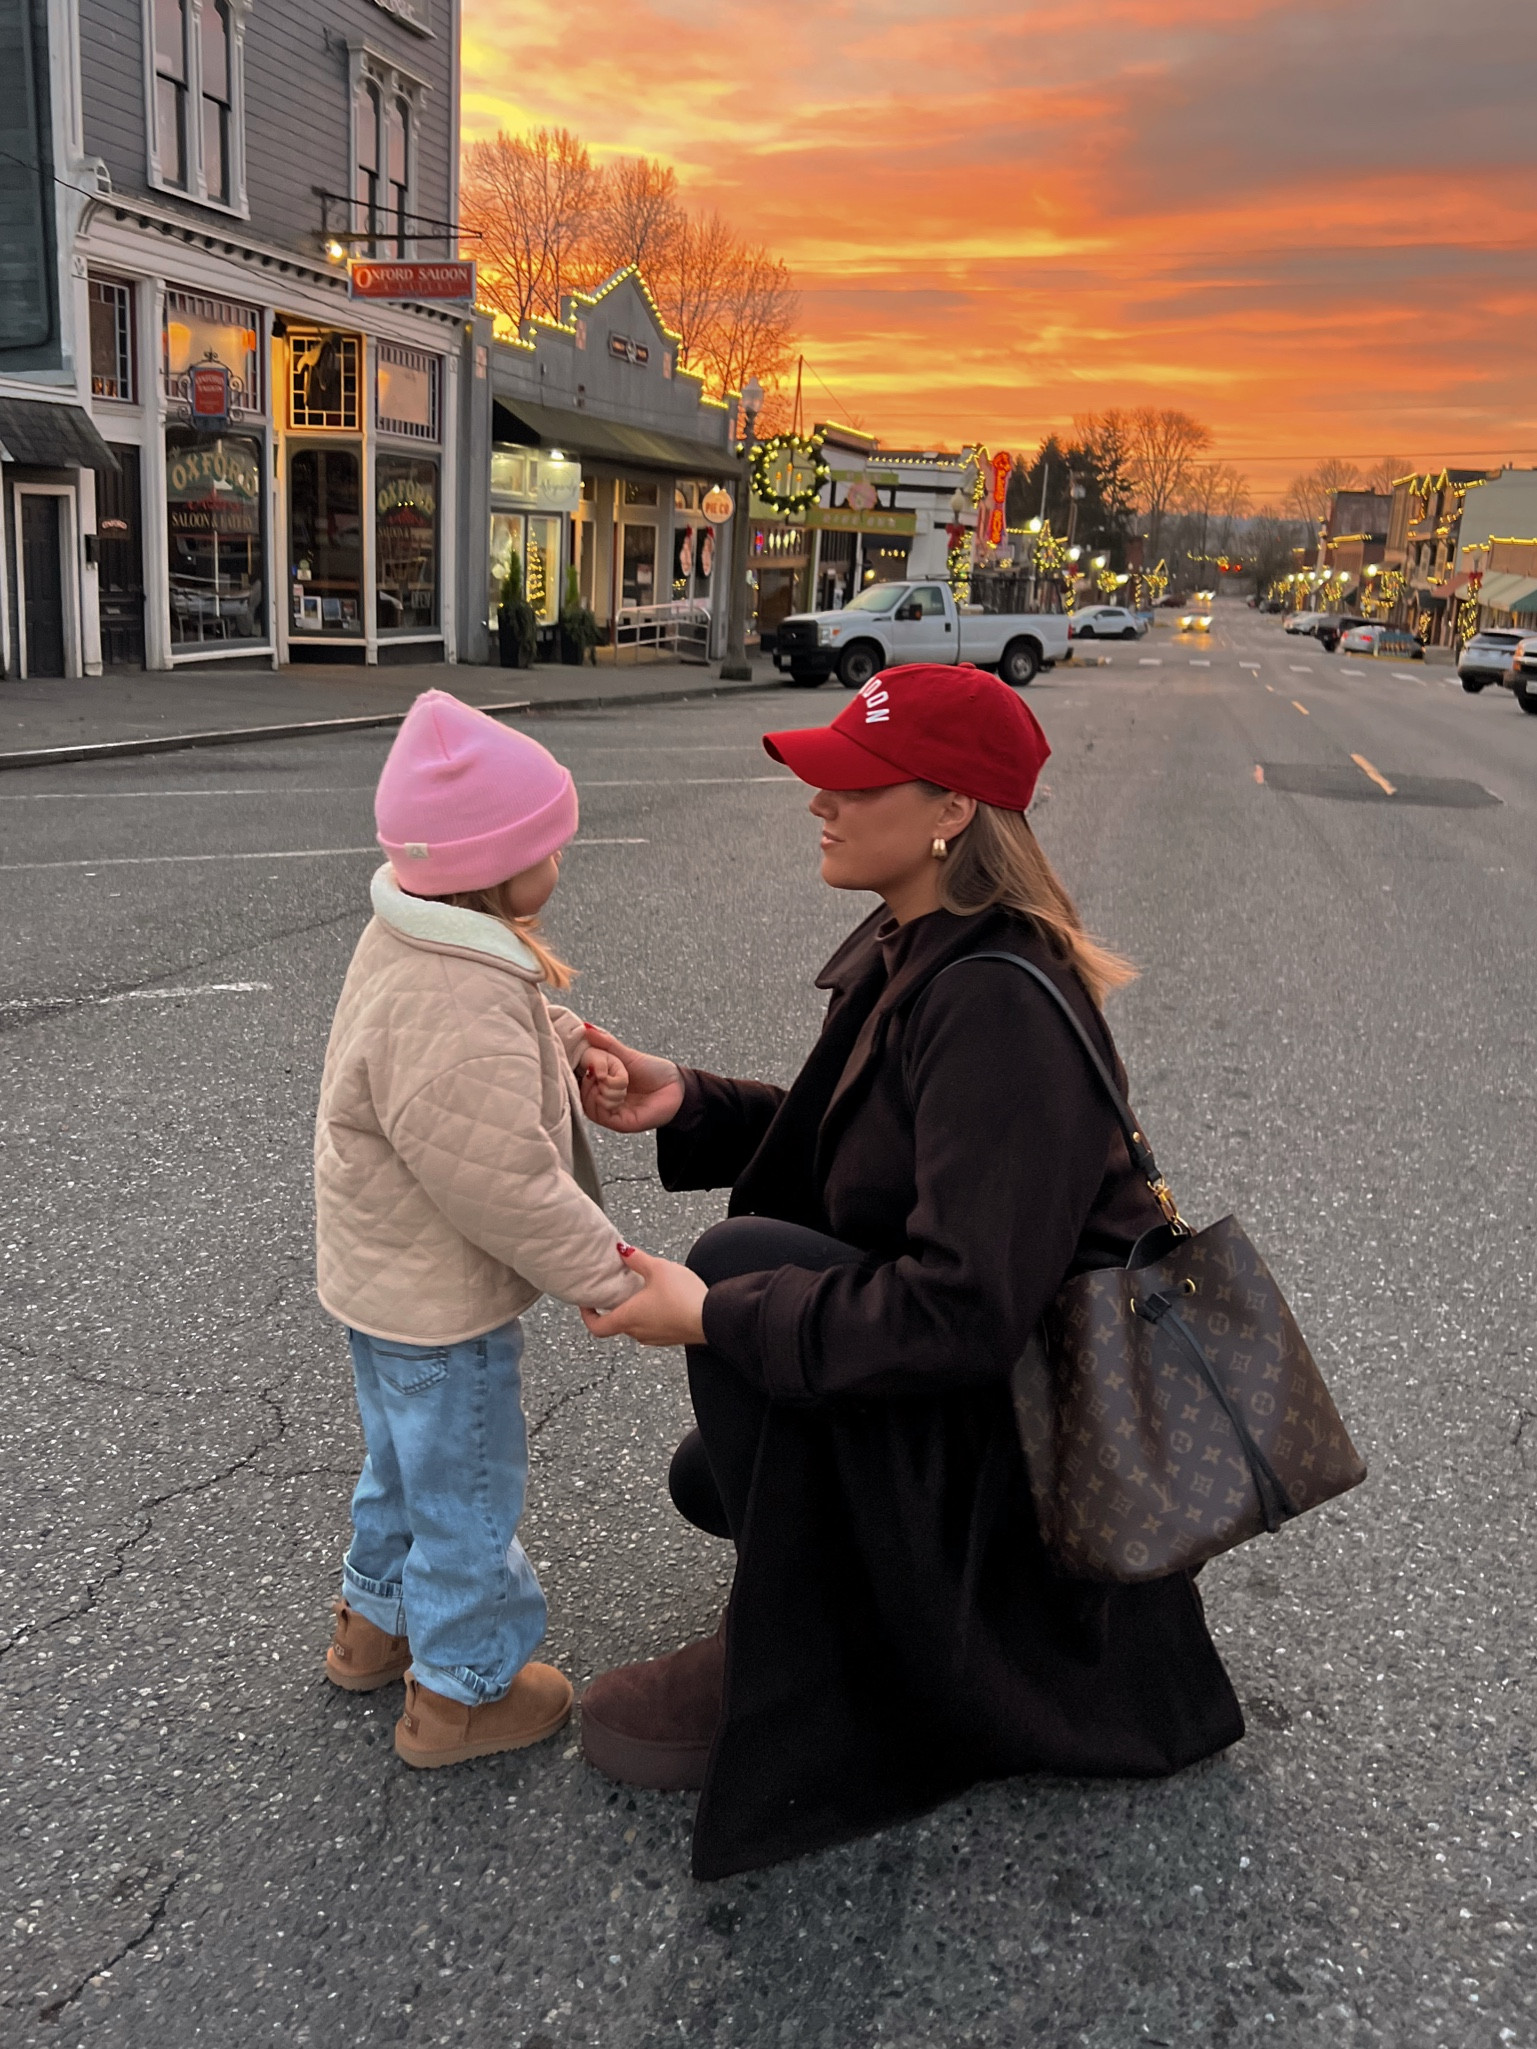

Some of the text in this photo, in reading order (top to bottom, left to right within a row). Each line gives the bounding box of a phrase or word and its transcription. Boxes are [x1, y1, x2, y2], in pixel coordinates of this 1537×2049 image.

[355, 268, 468, 289] OXFORD SALOON
[171, 452, 256, 498] OXFORD
[378, 478, 436, 516] OXFORD
[171, 511, 210, 528] SALOON
